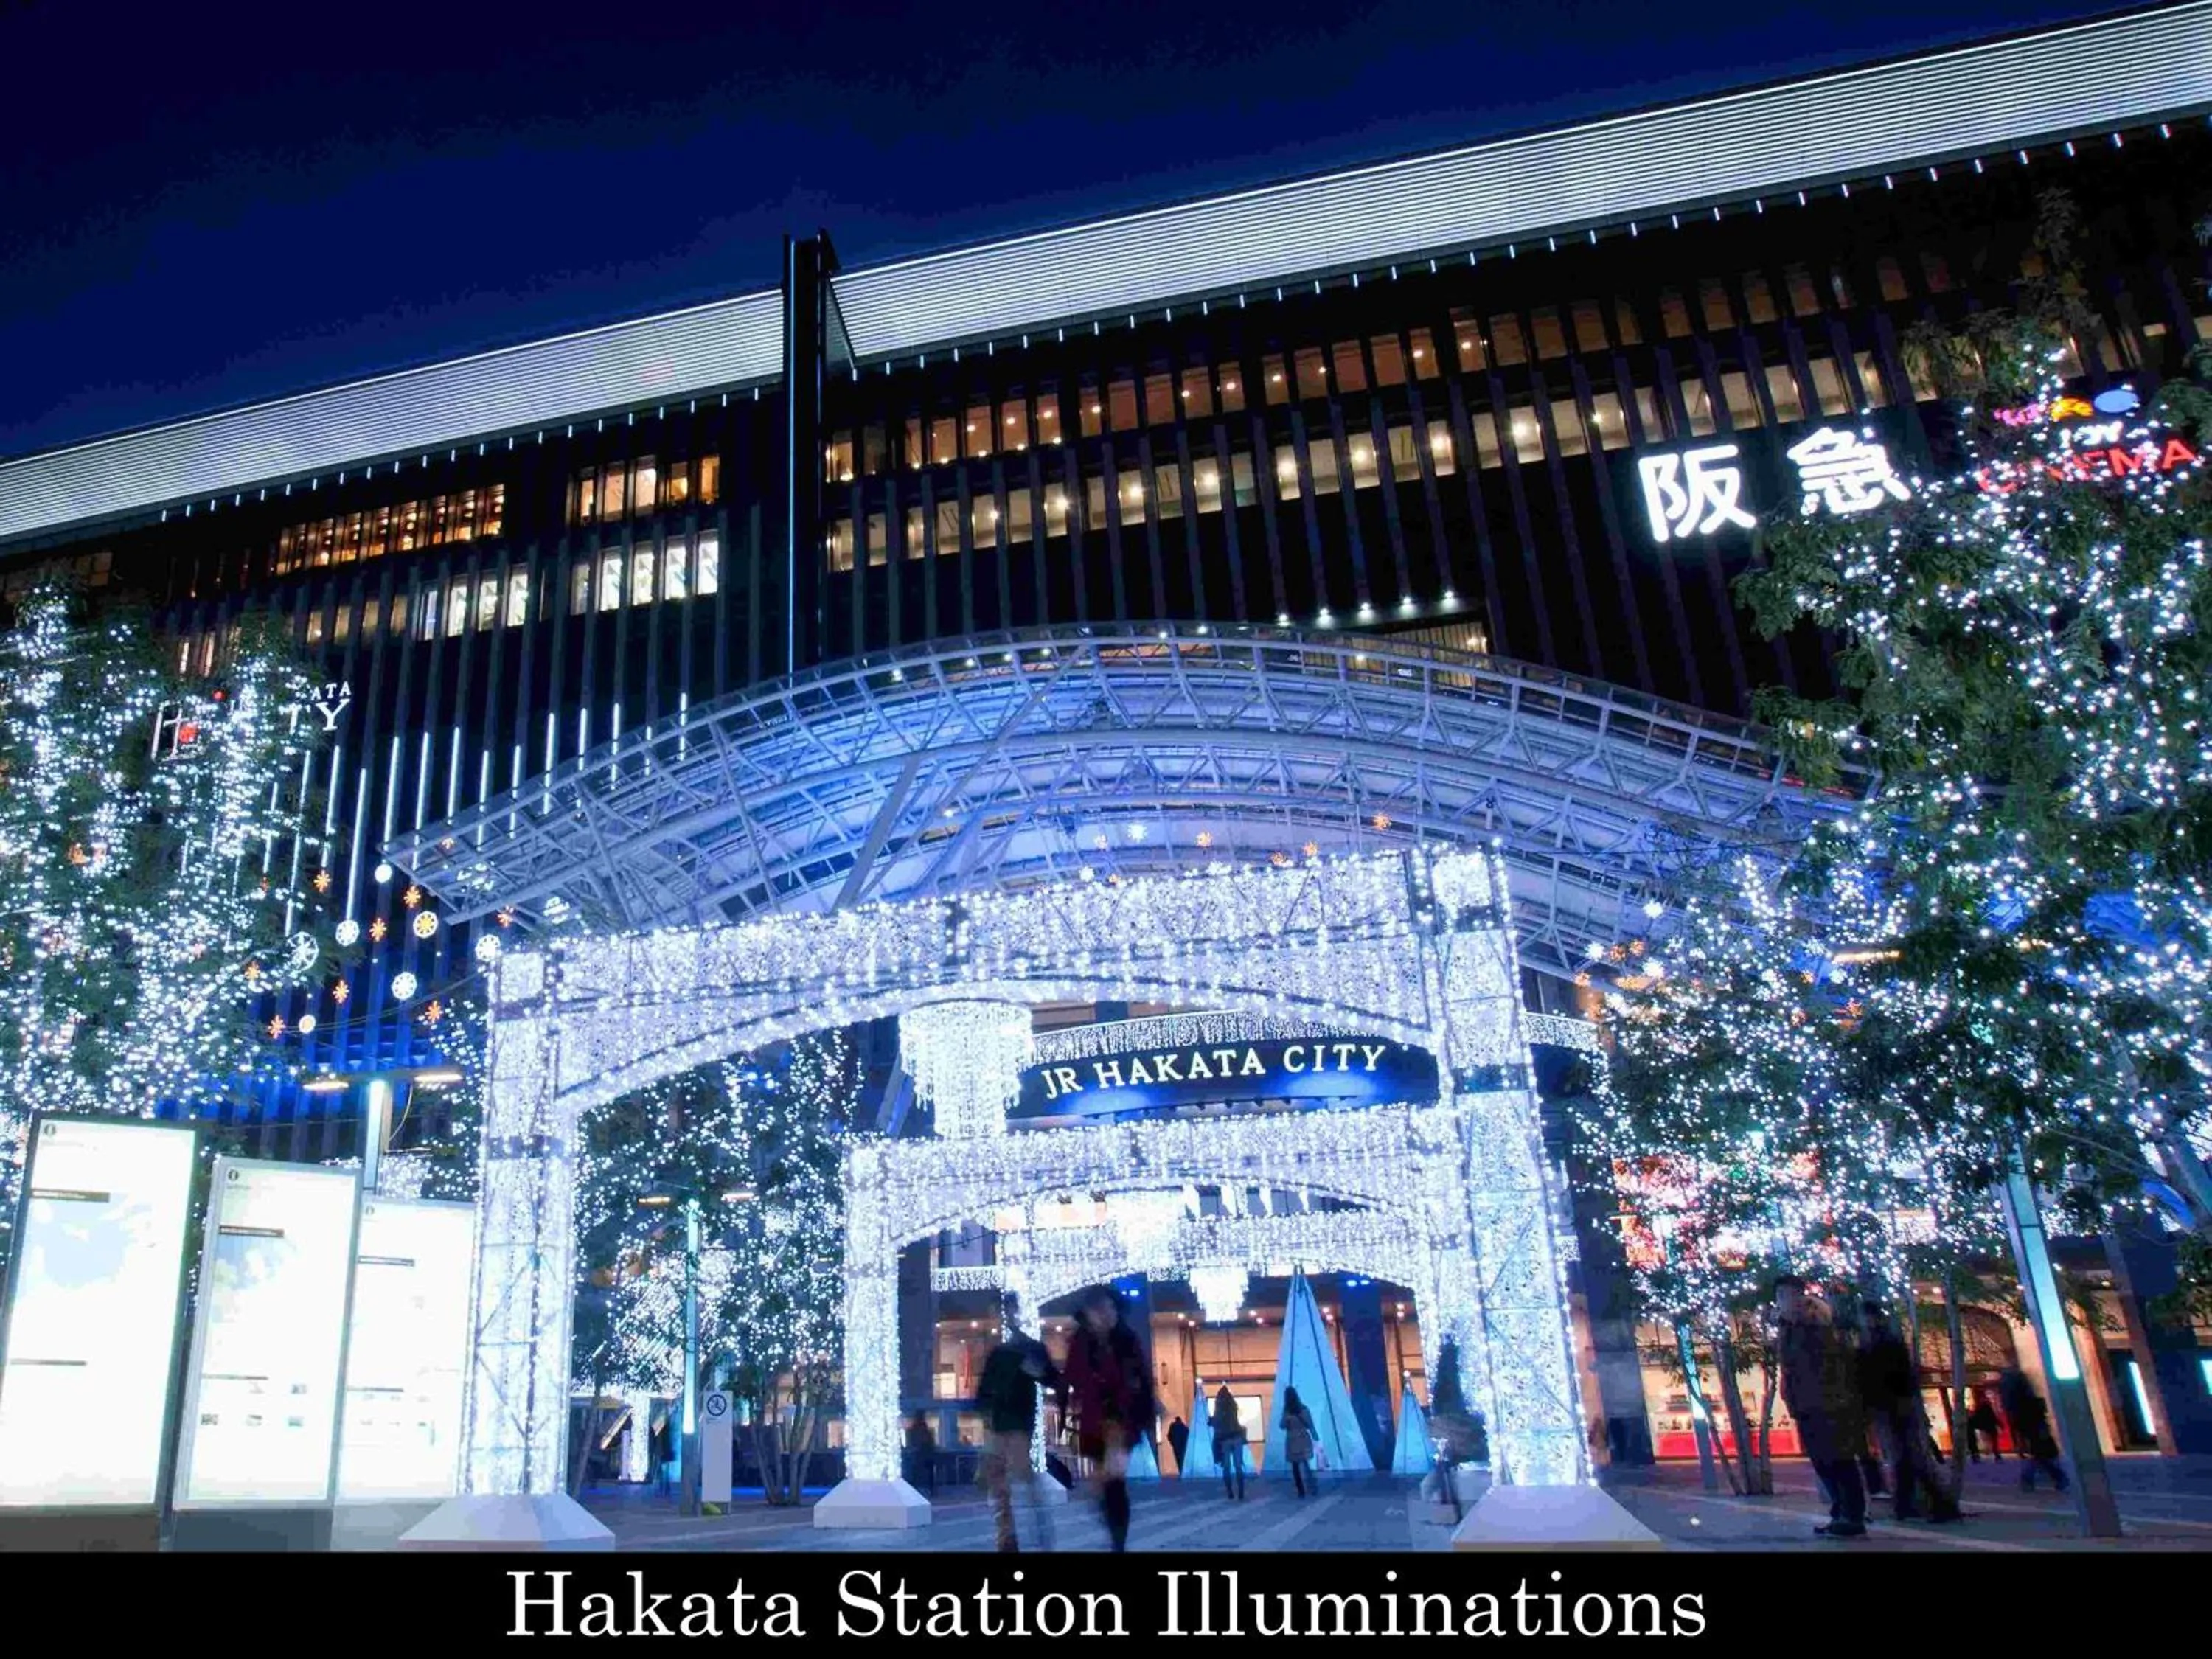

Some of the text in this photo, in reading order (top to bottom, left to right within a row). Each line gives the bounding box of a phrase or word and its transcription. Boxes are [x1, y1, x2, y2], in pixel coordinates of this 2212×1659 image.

[1638, 425, 1912, 542] 阪急
[1978, 439, 2196, 493] CEMA
[1041, 1044, 1386, 1099] JR HAKATA CITY
